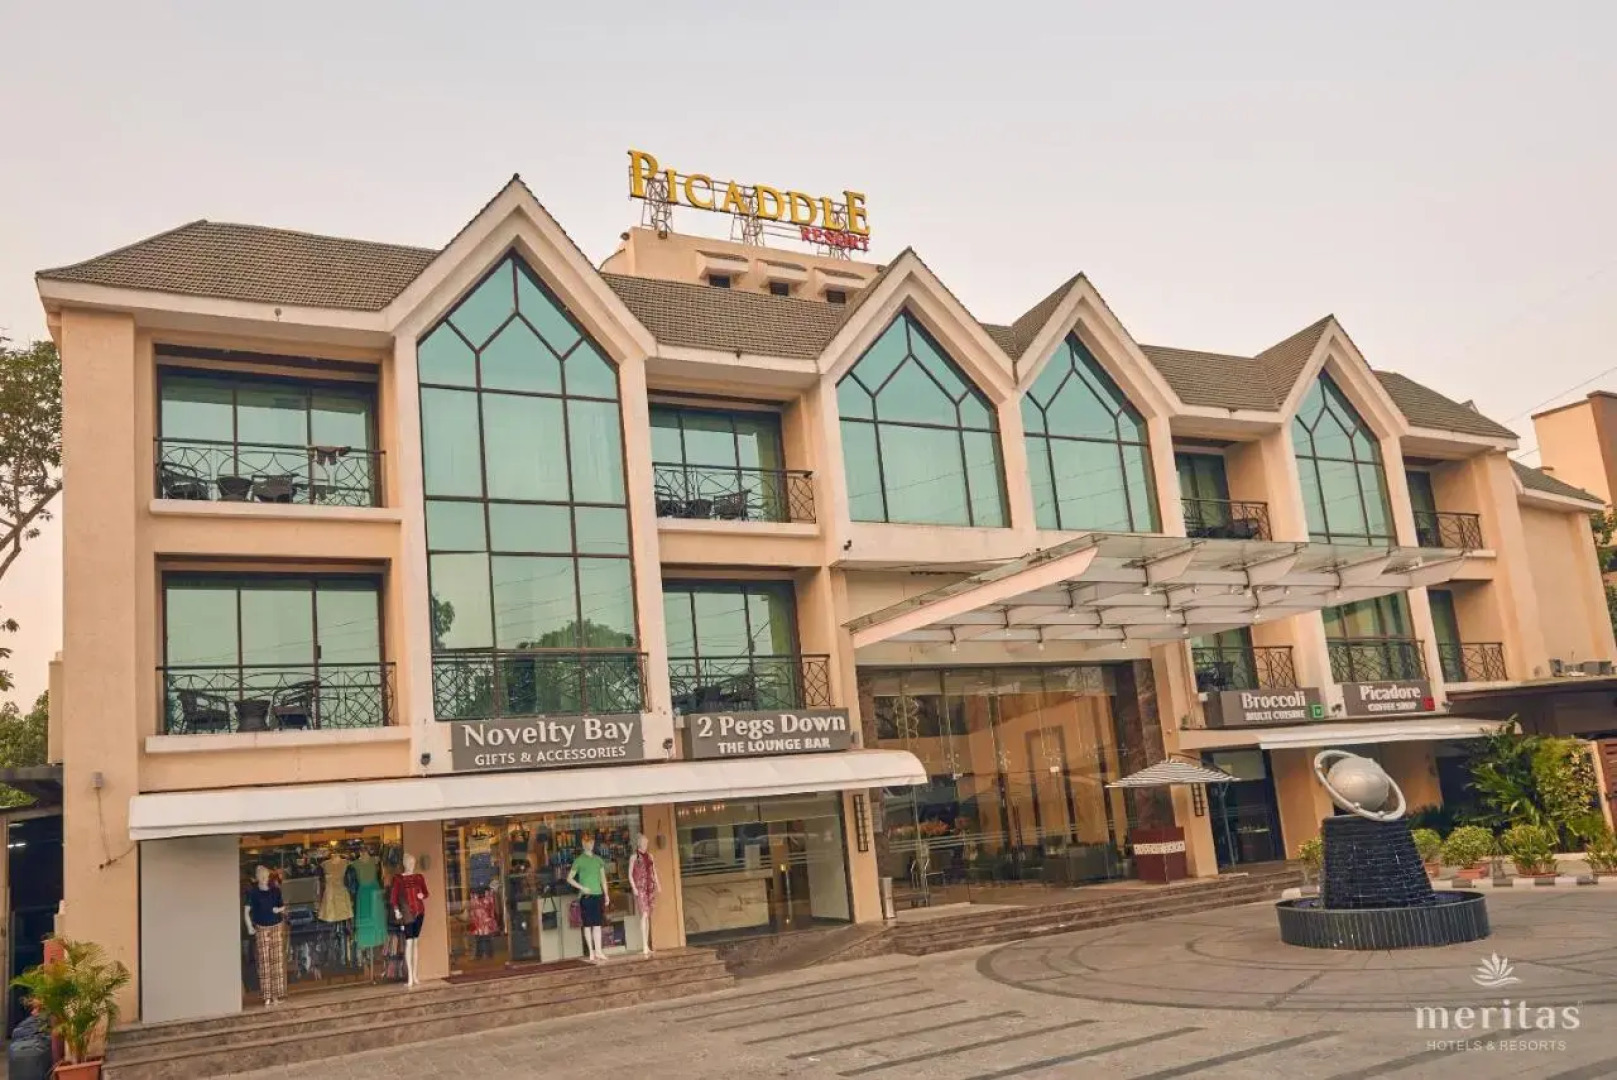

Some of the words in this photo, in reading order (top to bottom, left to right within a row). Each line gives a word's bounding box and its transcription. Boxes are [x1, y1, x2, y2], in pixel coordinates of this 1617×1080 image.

[627, 149, 870, 235] PICADDLE
[800, 225, 870, 251] RESORT
[1241, 692, 1306, 709] Broccoli
[1359, 685, 1421, 701] Picadore
[461, 720, 576, 748] Novelty
[582, 718, 634, 744] Bay
[697, 716, 714, 738] 2
[717, 715, 775, 740] Pegs
[779, 714, 846, 734] Down
[474, 753, 516, 767] GIFTS
[520, 752, 532, 763] &
[536, 746, 627, 763] ACCESSORIES
[718, 742, 745, 754] THE
[748, 738, 801, 752] LOUNGE
[804, 737, 831, 749] BAR
